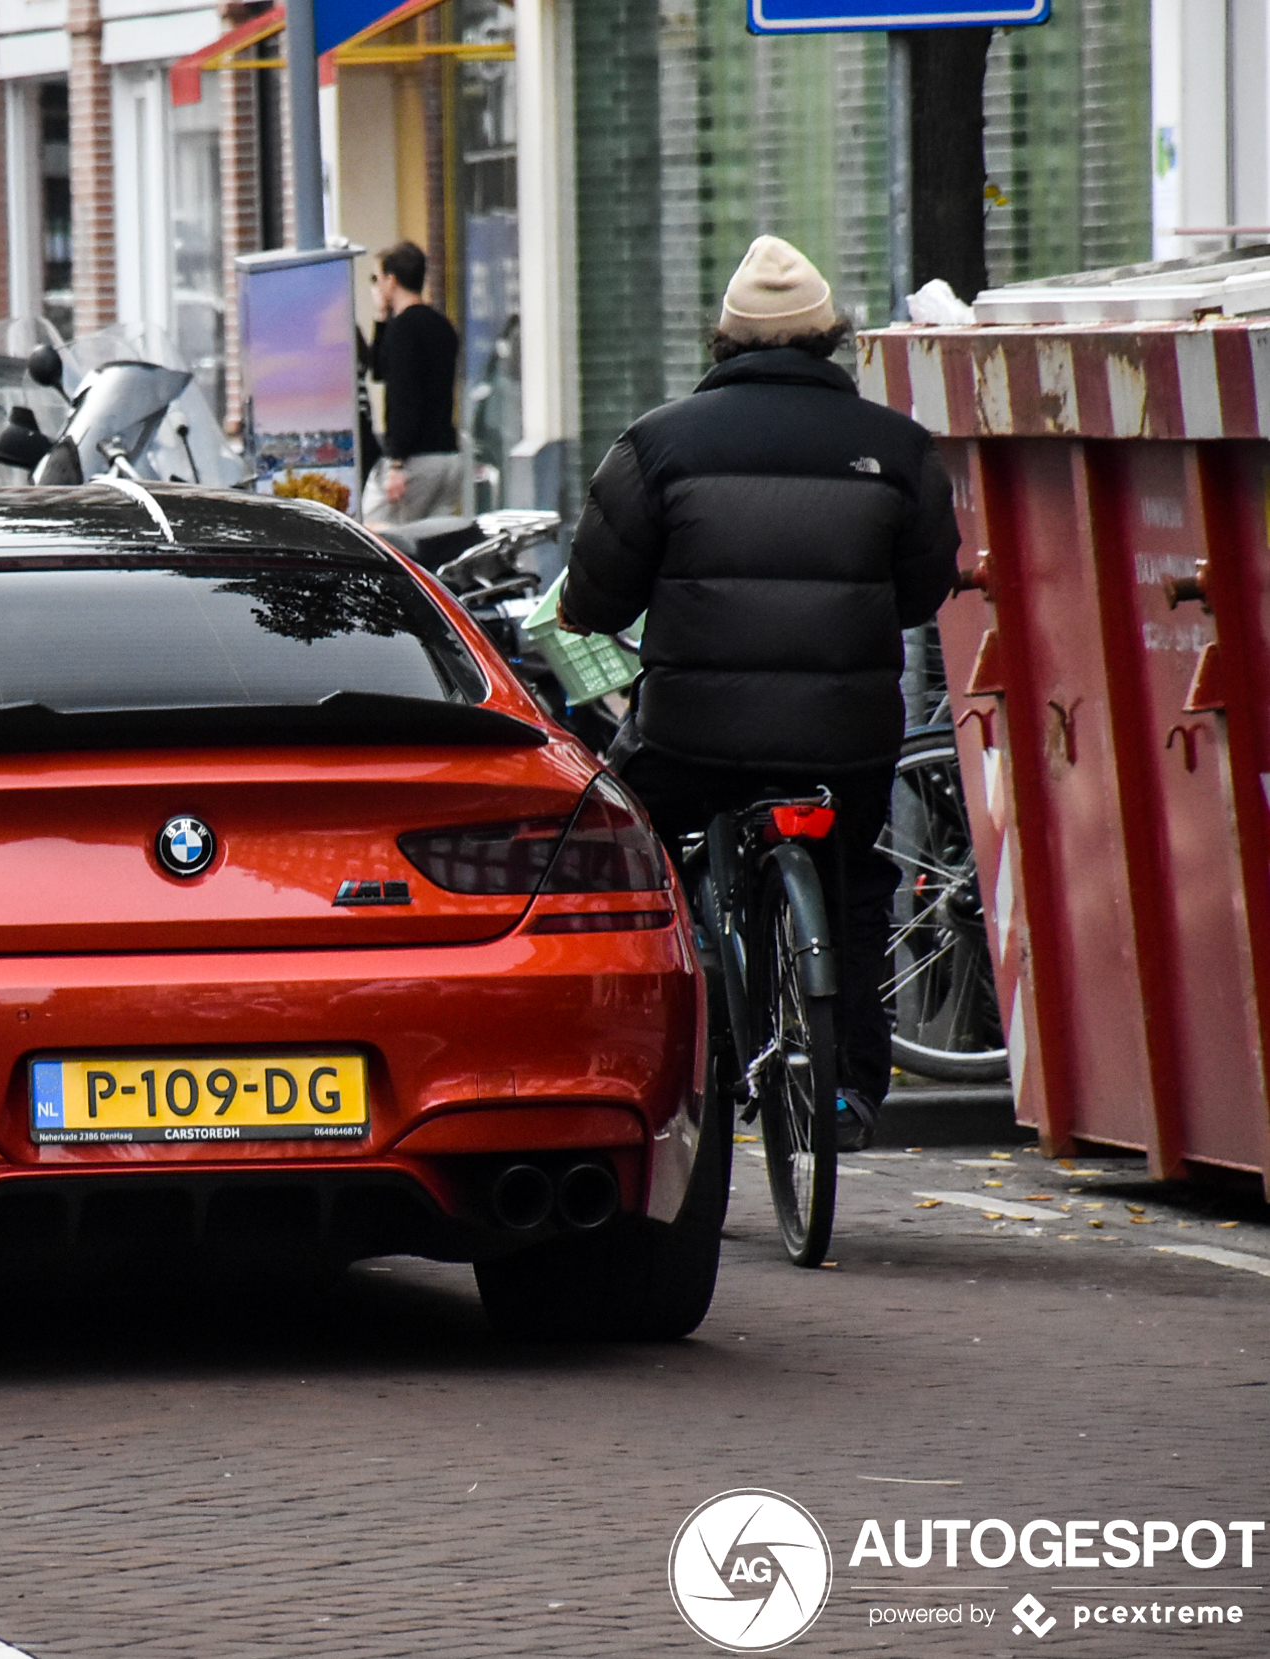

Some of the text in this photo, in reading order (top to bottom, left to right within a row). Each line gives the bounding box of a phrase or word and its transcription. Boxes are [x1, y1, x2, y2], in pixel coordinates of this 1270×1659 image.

[165, 819, 208, 838] BMW
[87, 1067, 341, 1118] P-109-DG
[37, 1102, 59, 1118] NL
[164, 1127, 240, 1140] CARSTOREDH
